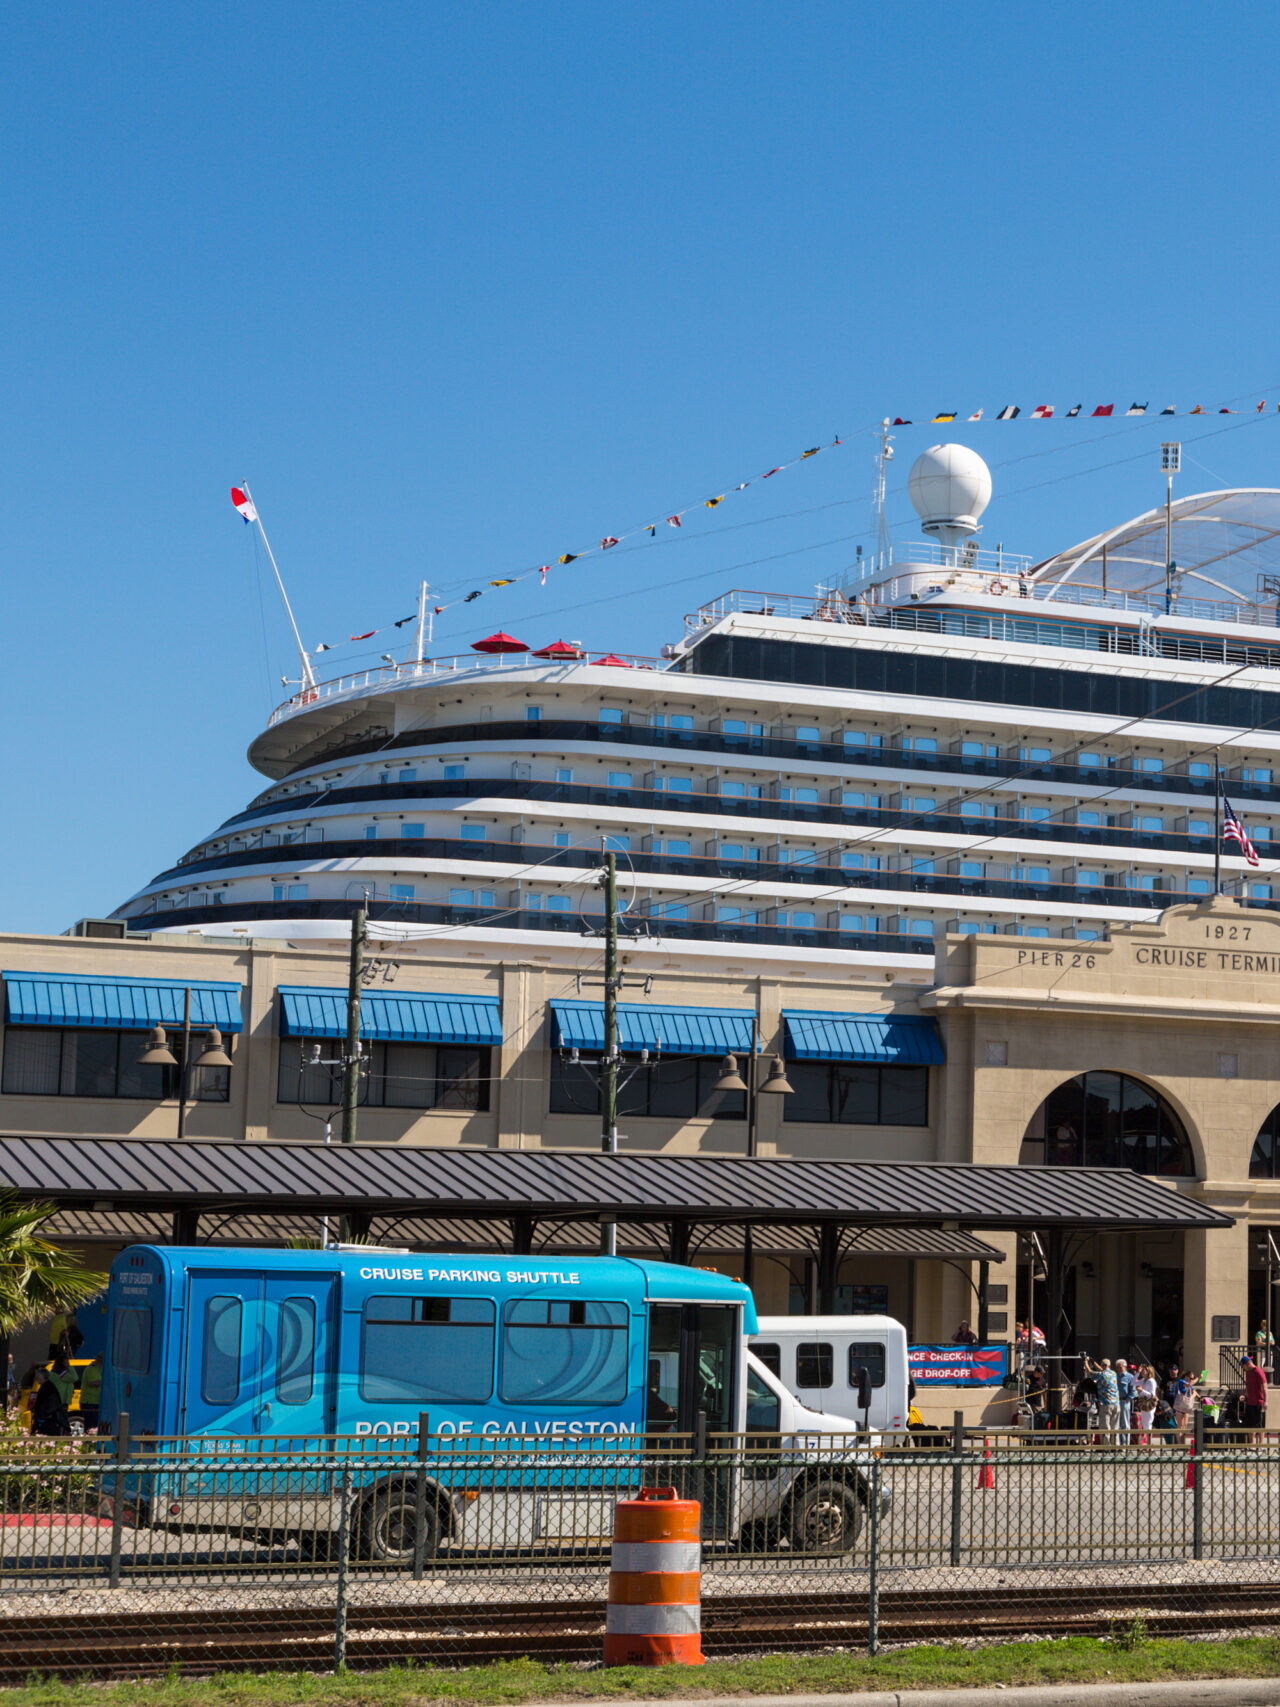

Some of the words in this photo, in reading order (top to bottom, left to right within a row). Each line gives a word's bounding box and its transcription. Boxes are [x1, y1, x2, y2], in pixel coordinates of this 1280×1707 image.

[1205, 925, 1252, 941] 1927
[1018, 950, 1063, 966] PIER
[1072, 954, 1096, 969] 26
[1136, 948, 1207, 968] CRUISE
[360, 1267, 424, 1281] CRUISE
[428, 1270, 501, 1282] PARKING
[506, 1271, 581, 1285] SHUTTLE
[929, 1352, 974, 1361] CHECK-IN
[925, 1369, 971, 1378] DROP-OFF
[355, 1421, 420, 1442] PORT
[437, 1421, 473, 1442] OF
[482, 1421, 636, 1442] GALVESTON
